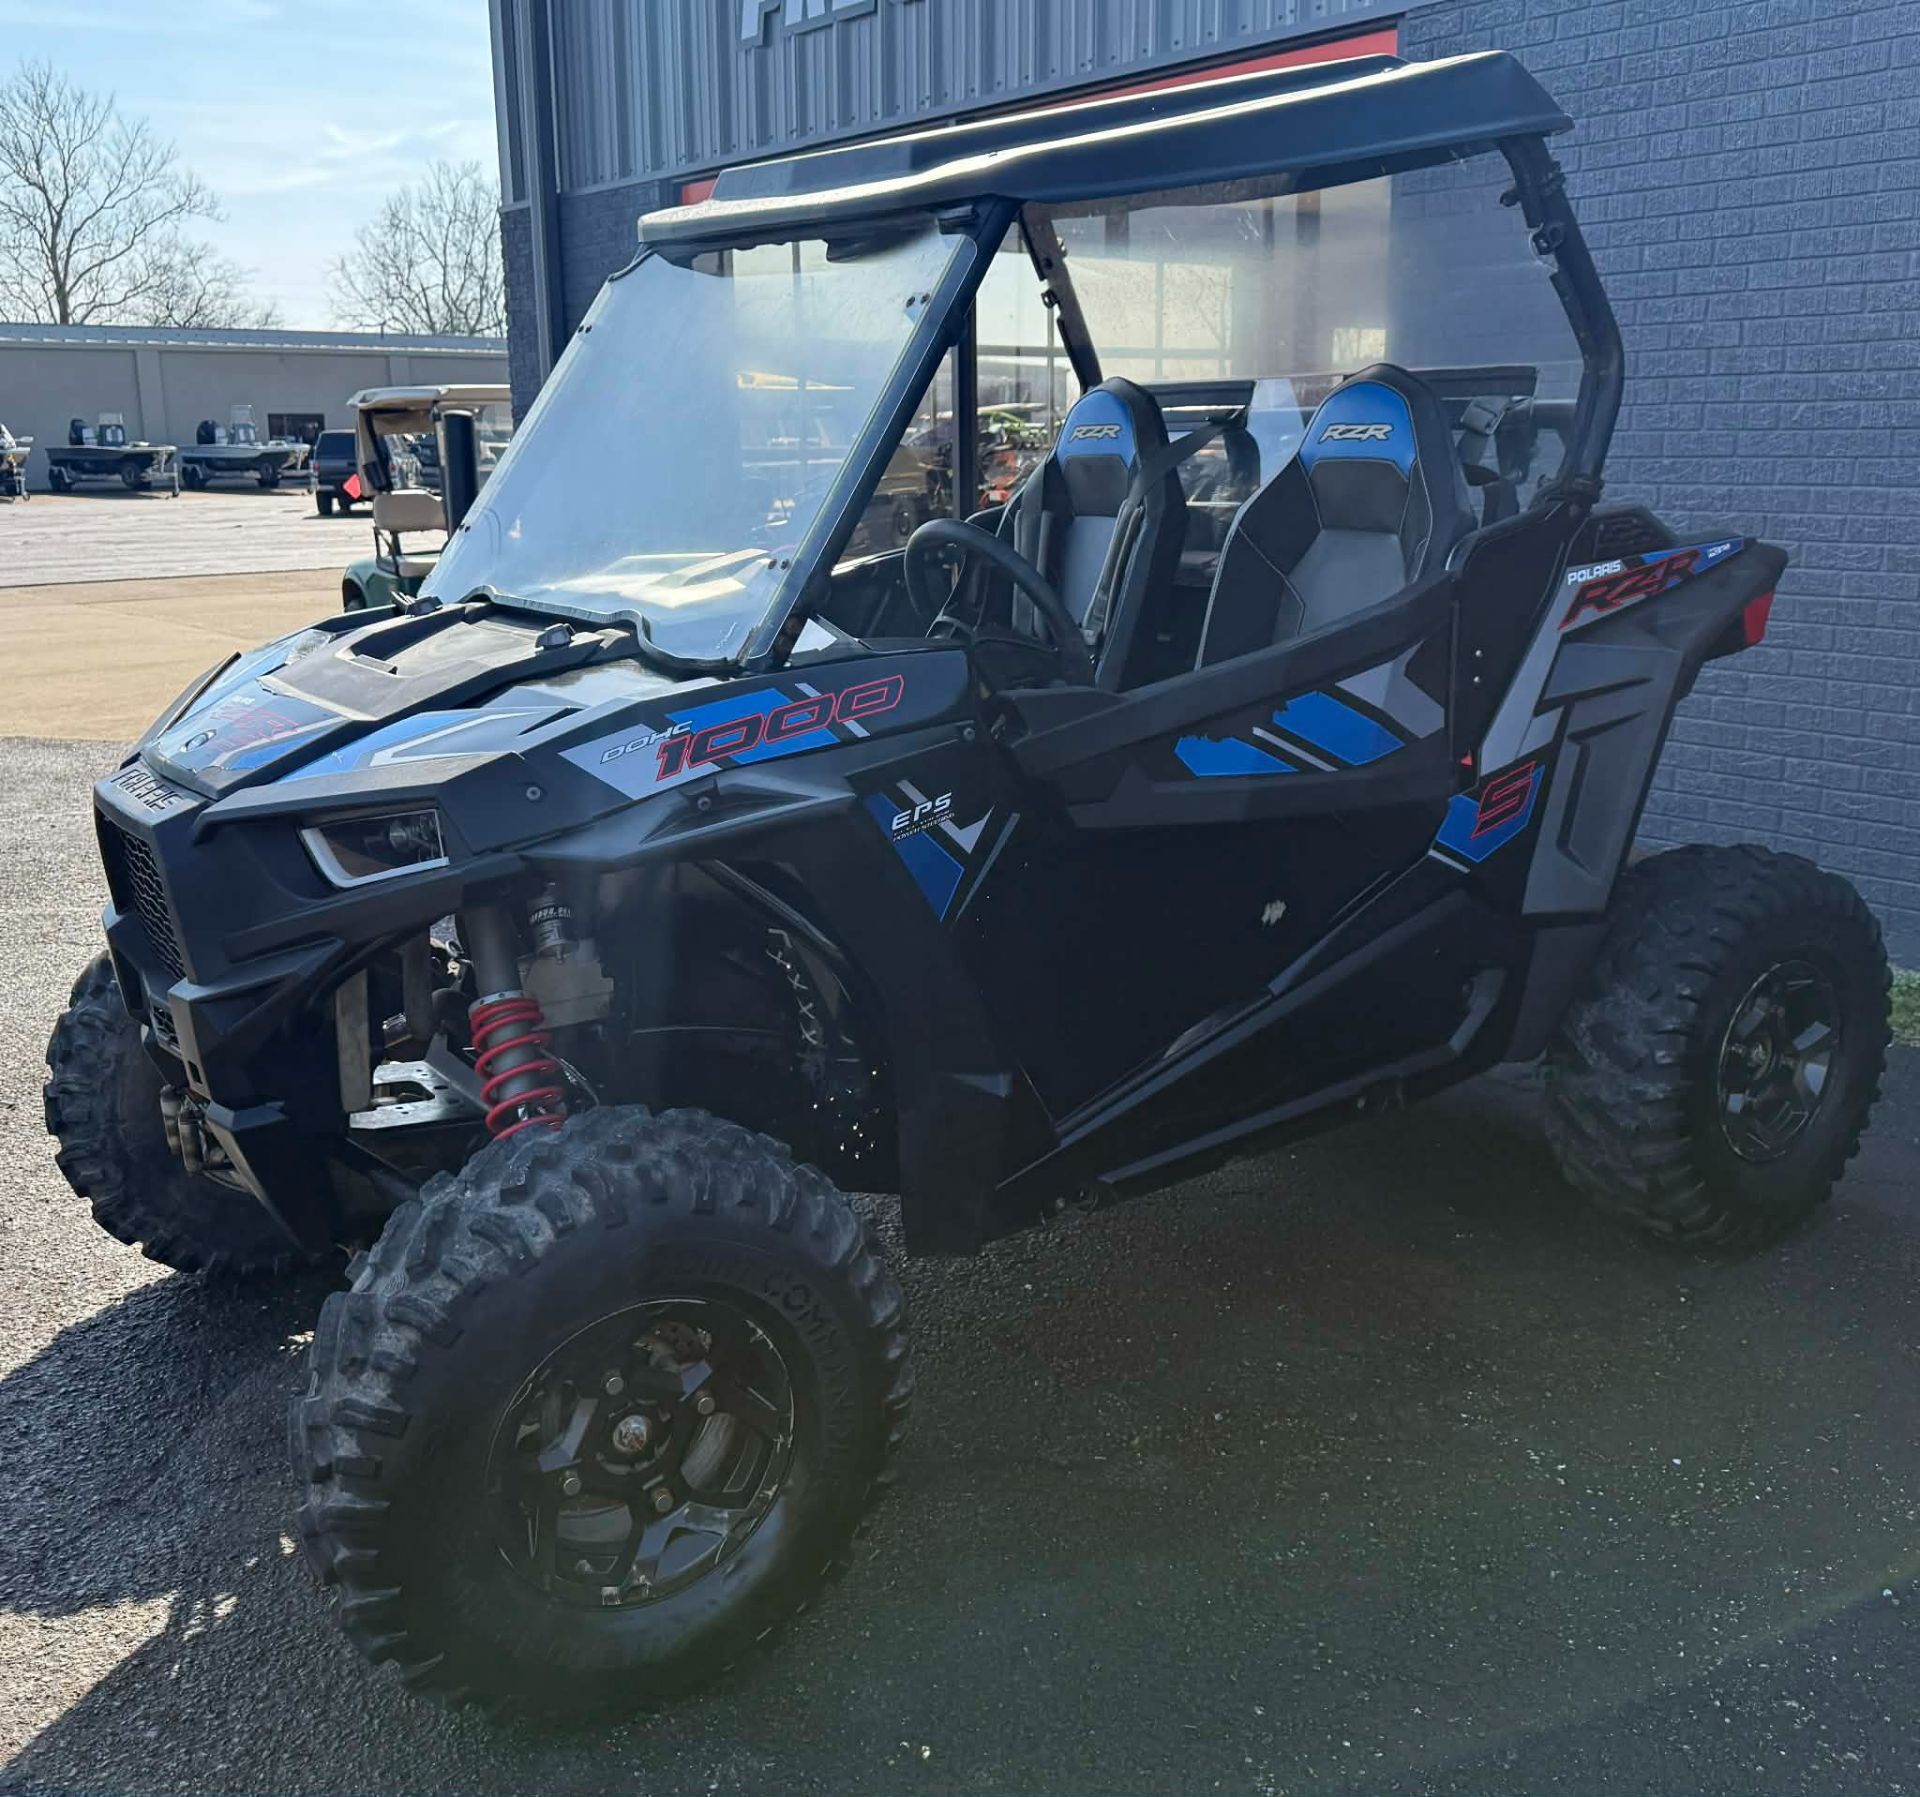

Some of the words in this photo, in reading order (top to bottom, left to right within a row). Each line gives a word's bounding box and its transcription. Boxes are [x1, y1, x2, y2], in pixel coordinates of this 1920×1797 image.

[1068, 424, 1121, 443] RZR
[1317, 423, 1394, 443] RZR
[1558, 548, 1700, 631] RZR
[1567, 559, 1622, 586] POLARIS
[600, 720, 692, 764] DOHC
[656, 674, 904, 782] 1000
[891, 792, 952, 831] EPS
